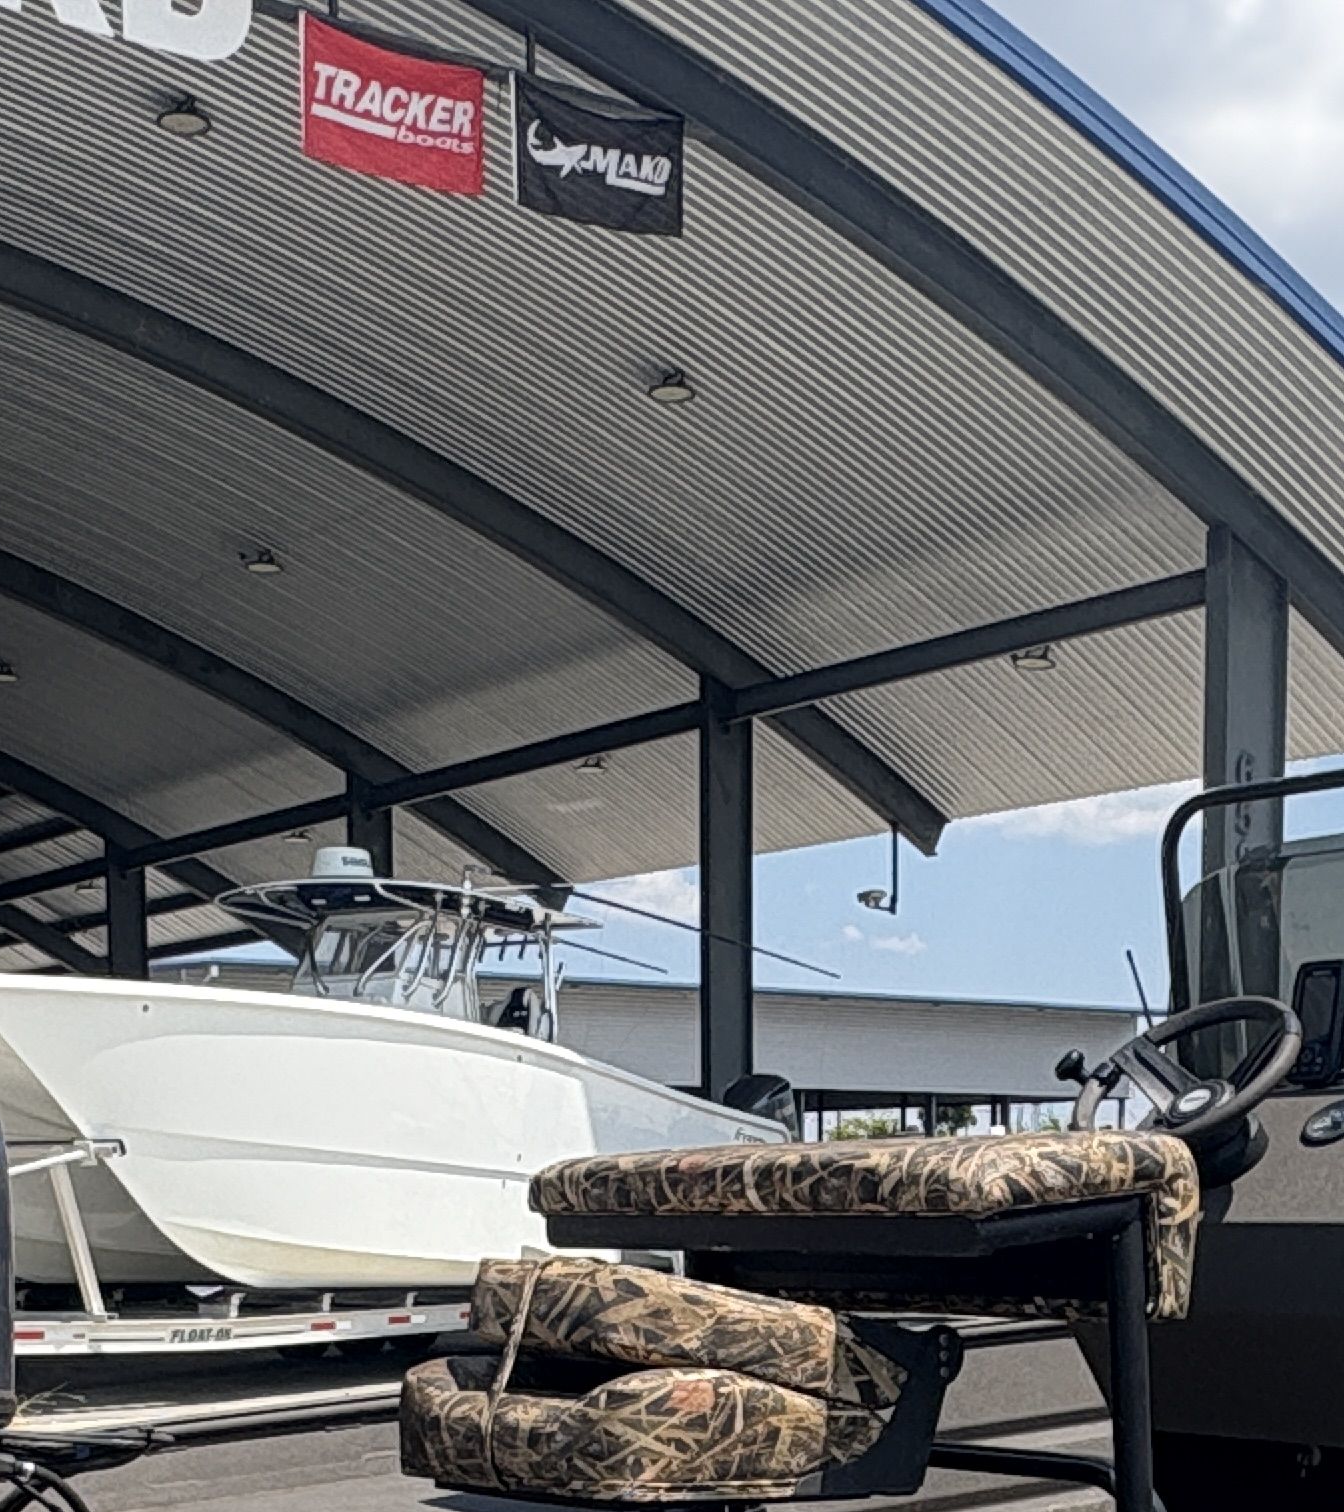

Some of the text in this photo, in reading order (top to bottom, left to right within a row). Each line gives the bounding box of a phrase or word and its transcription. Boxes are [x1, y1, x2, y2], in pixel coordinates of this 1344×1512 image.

[312, 61, 475, 137] TRACKER
[397, 125, 475, 153] boats
[580, 144, 672, 196] MAKO
[169, 1327, 233, 1344] FLOAT-ON
